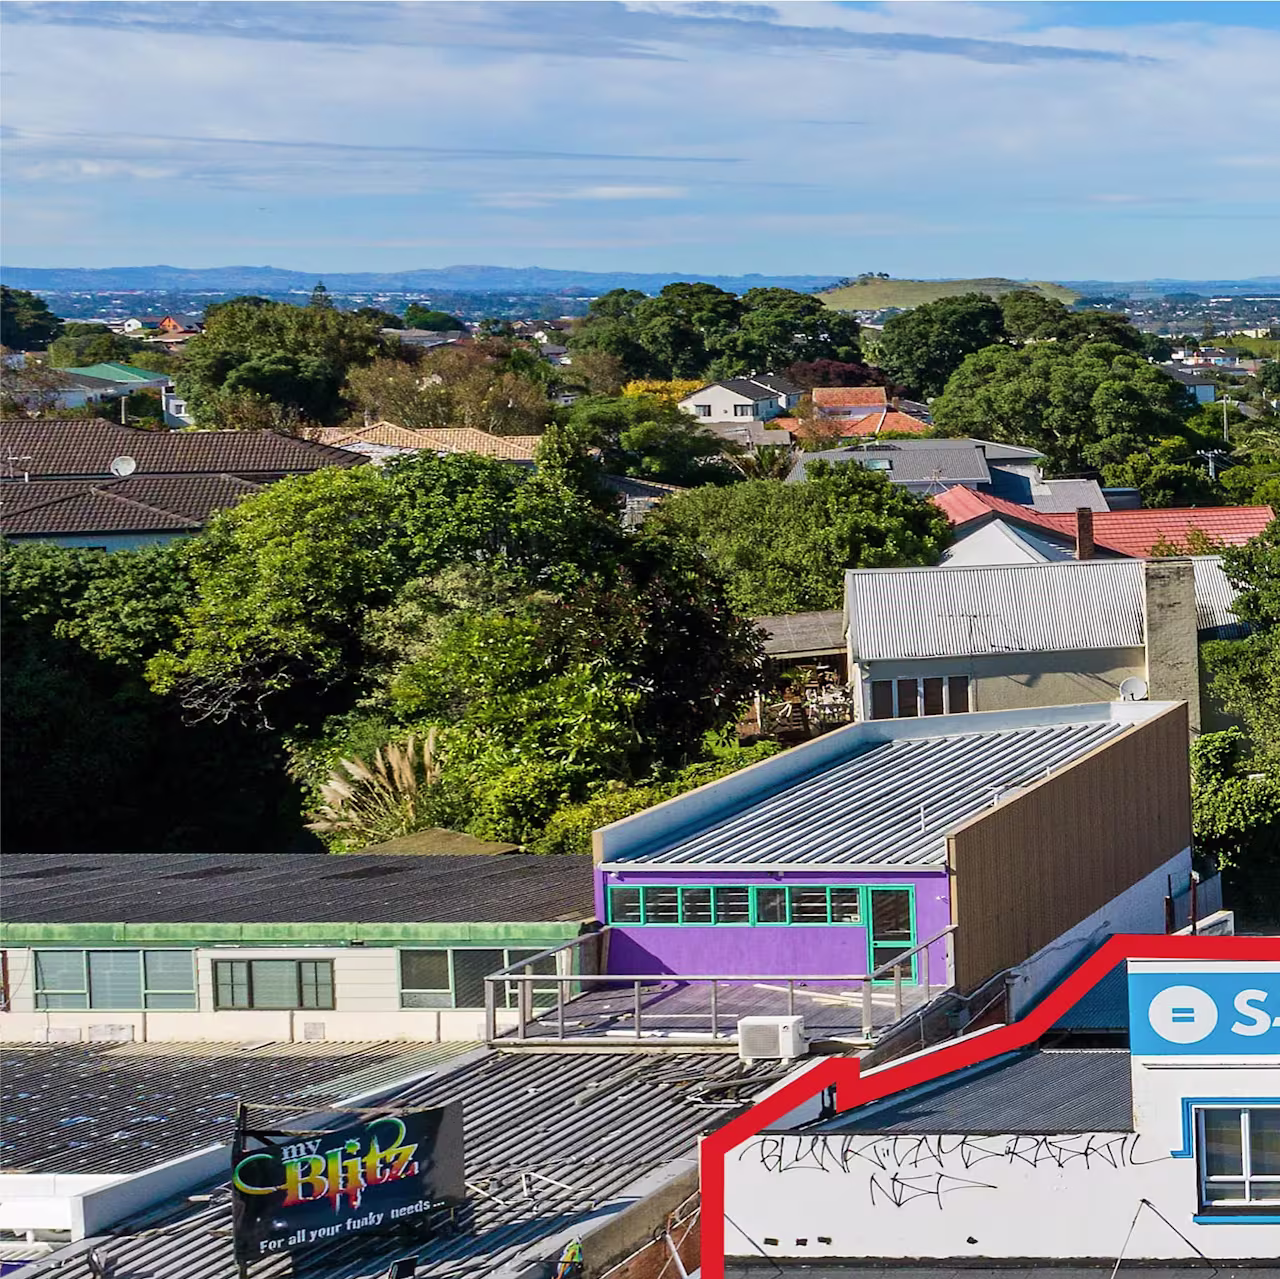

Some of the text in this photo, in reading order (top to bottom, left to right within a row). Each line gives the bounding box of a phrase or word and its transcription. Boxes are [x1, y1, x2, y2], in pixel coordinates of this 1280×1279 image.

[233, 1117, 420, 1216] my Blitz
[259, 1239, 285, 1254] For
[288, 1228, 306, 1246] all
[309, 1222, 342, 1243] your
[346, 1211, 384, 1232] funky
